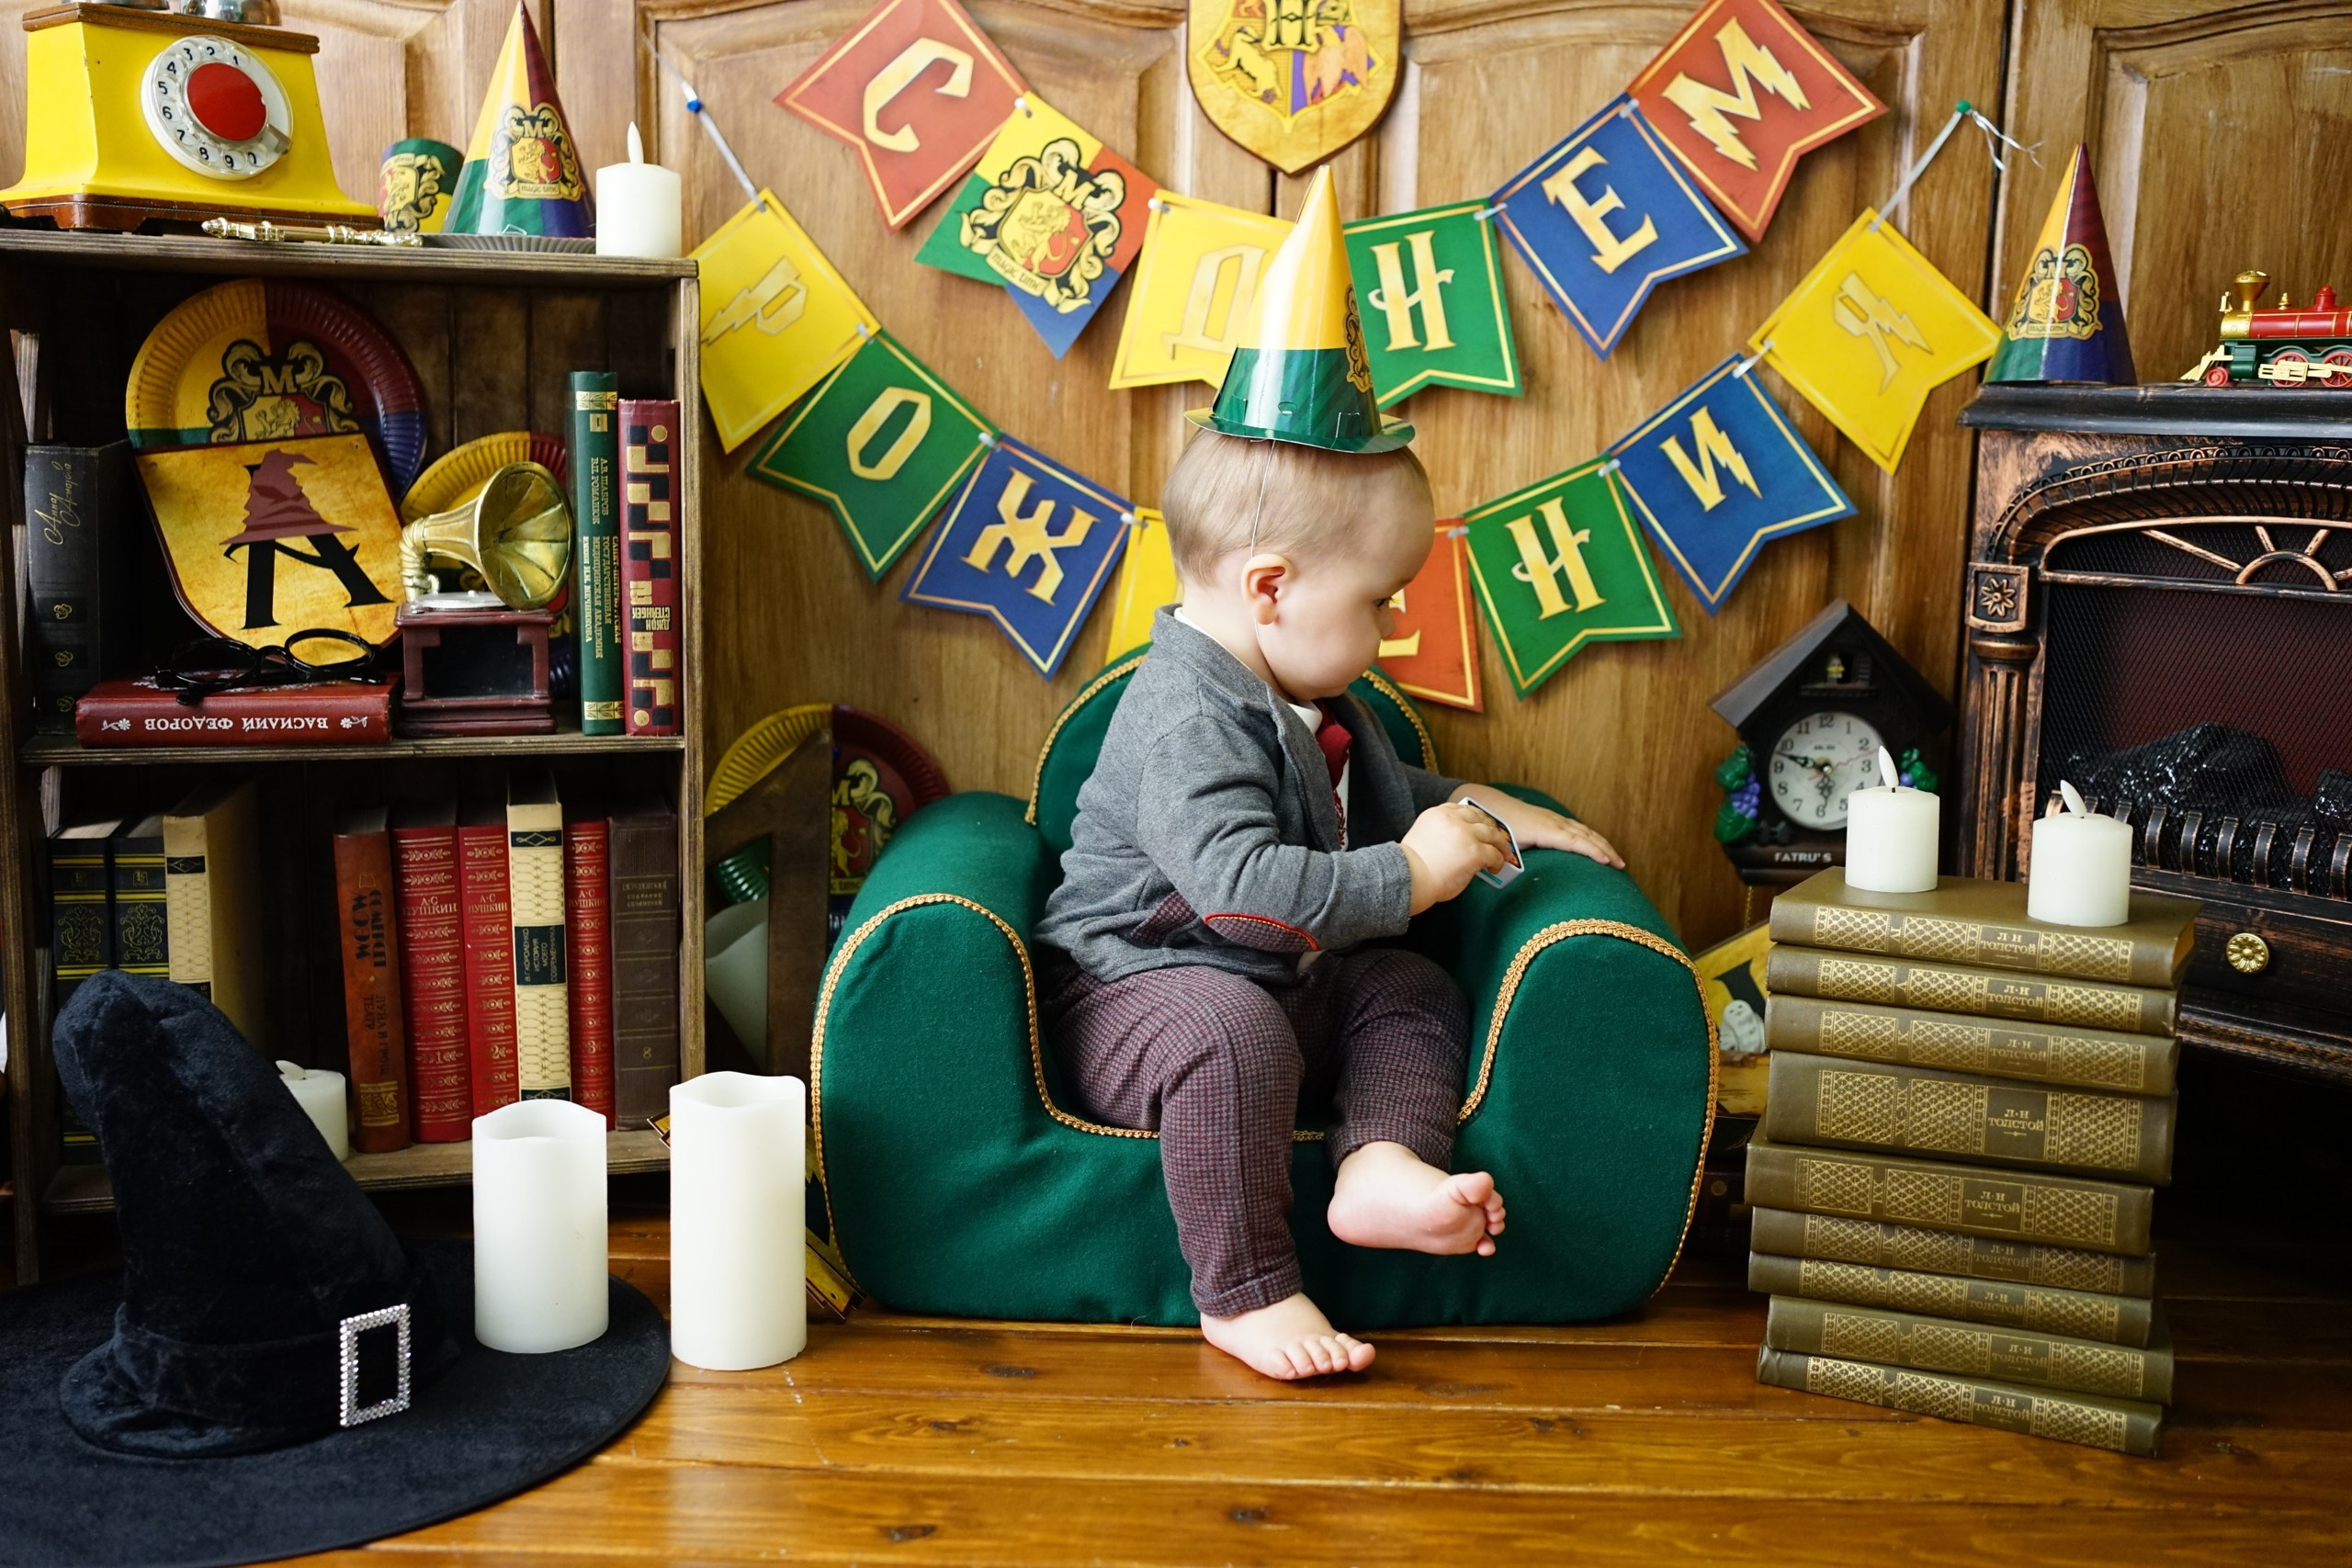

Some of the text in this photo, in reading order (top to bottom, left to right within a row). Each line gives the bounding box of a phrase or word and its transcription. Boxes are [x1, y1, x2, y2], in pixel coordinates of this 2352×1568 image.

[183, 48, 194, 61] 3
[232, 55, 239, 65] 1
[166, 62, 176, 74] 4
[158, 81, 168, 95] 5
[162, 106, 173, 119] 6
[176, 130, 185, 141] 7
[524, 119, 544, 139] M
[199, 147, 209, 161] 8
[224, 154, 234, 169] 9
[1054, 169, 1096, 209] M
[990, 253, 1043, 291] magic time
[260, 365, 297, 395] M
[646, 619, 671, 631] ДЖОН
[144, 716, 329, 733] ВАСИЛИЙ ФЕДОРОВ
[403, 903, 458, 916] ПУШКИН
[468, 902, 508, 913] ПУШКИН
[568, 897, 605, 908] ПУШКИН
[1981, 940, 2037, 955] ТОЛСТОЙ
[1987, 992, 2043, 1008] ТОЛСТОЙ
[1989, 1048, 2047, 1062] ТОЛСТОЙ
[1987, 1117, 2044, 1131] ТОЛСТОЙ
[1964, 1199, 2020, 1213] ТОЛСТОЙ
[1974, 1253, 2030, 1268] ТОЛСТОЙ
[1970, 1300, 2024, 1314] ТОЛСТОЙ
[1992, 1352, 2050, 1367] ТОЛСТОЙ
[1975, 1403, 2030, 1420] ТОЛСТОЙ
